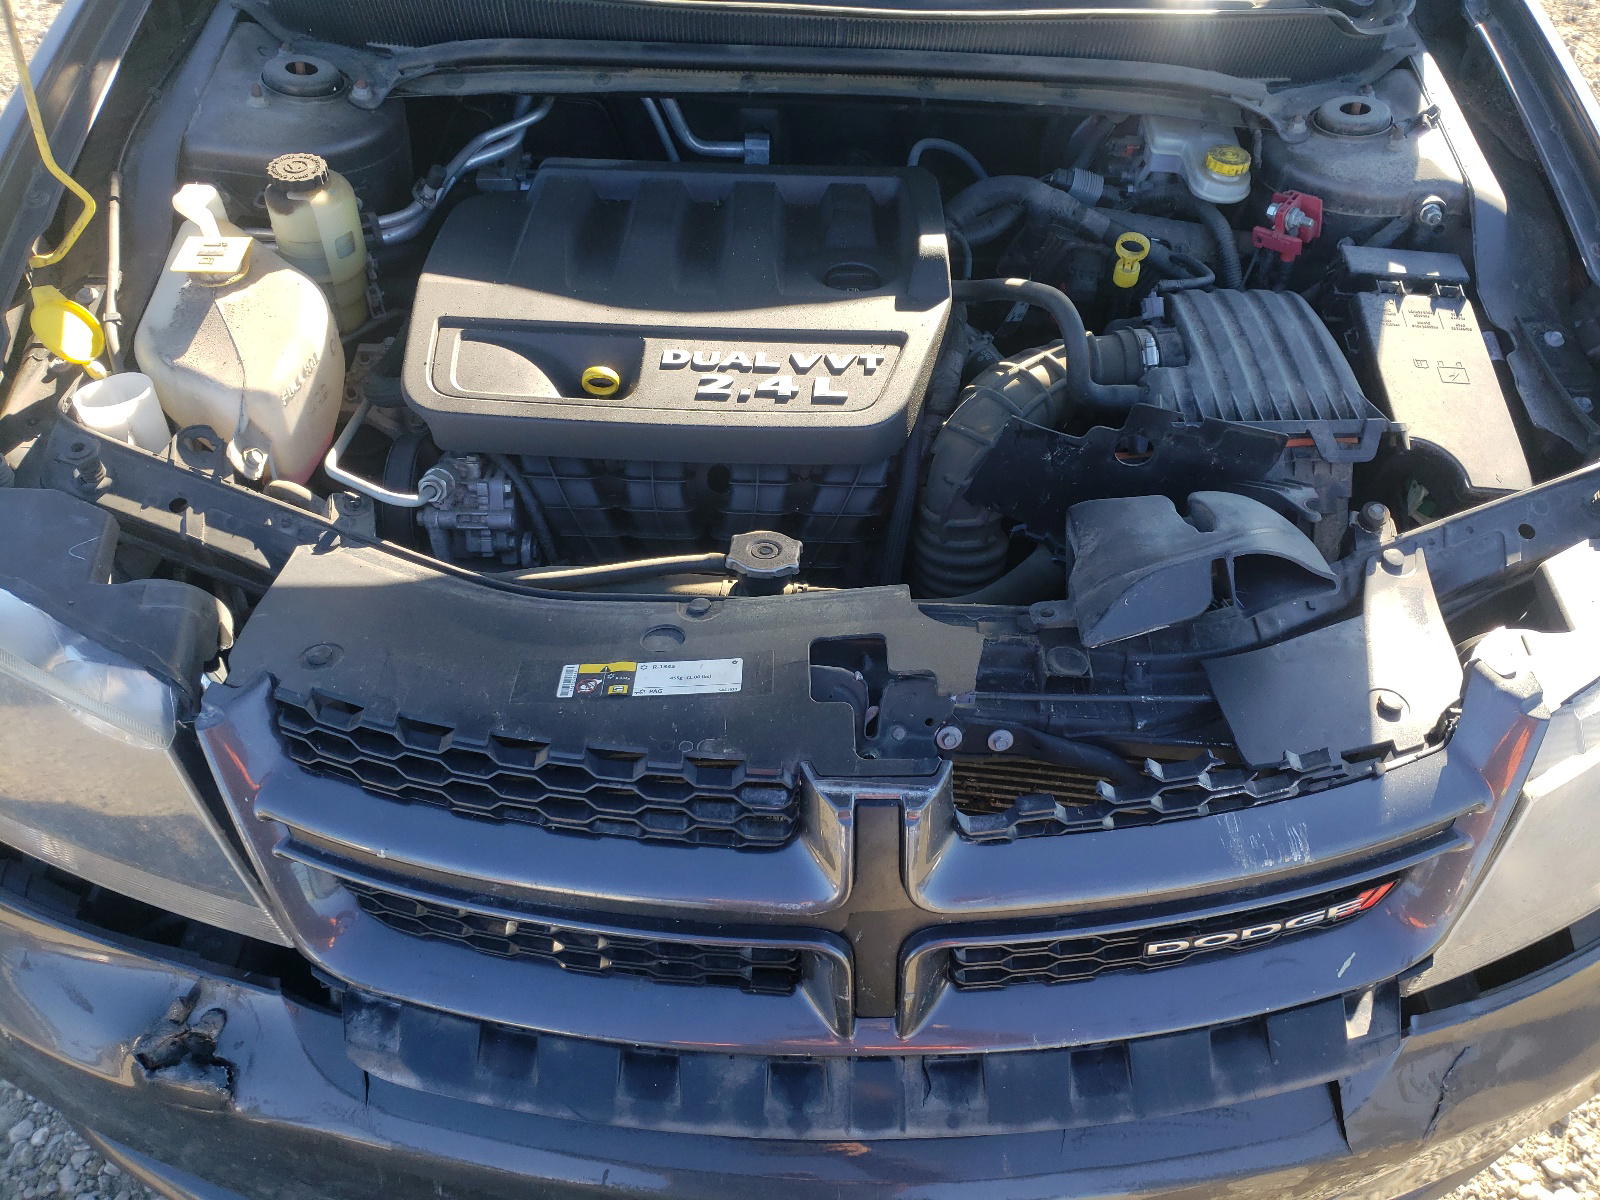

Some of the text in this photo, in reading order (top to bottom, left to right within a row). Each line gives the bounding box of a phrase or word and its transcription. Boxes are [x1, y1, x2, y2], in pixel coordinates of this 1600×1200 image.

[660, 349, 885, 376] DUAL VVT
[1146, 898, 1365, 957] DODGE
